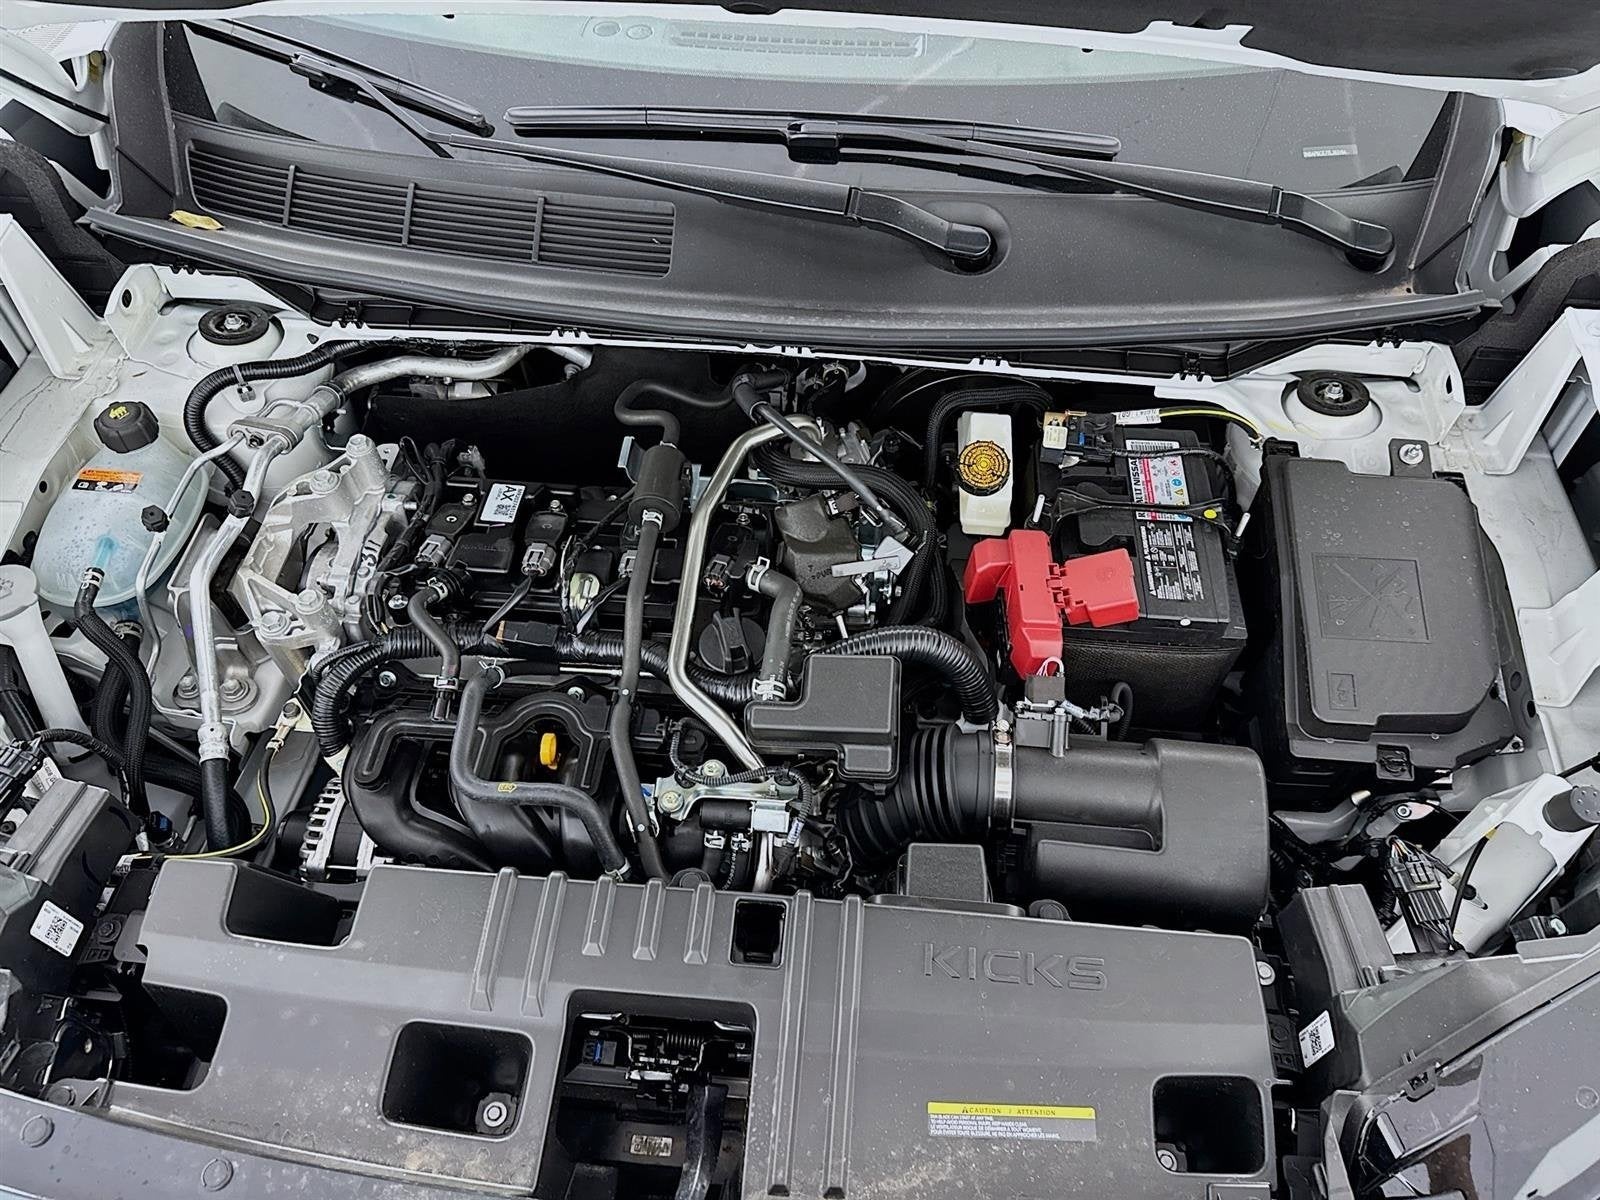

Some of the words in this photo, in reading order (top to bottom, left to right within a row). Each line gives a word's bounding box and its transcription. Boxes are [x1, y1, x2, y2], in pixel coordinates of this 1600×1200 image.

[1130, 457, 1141, 486] NISSA
[500, 485, 517, 501] AX
[924, 942, 1108, 991] KICKS
[969, 1106, 1001, 1114] CAUTION
[1016, 1108, 1056, 1116] ATTENTION
